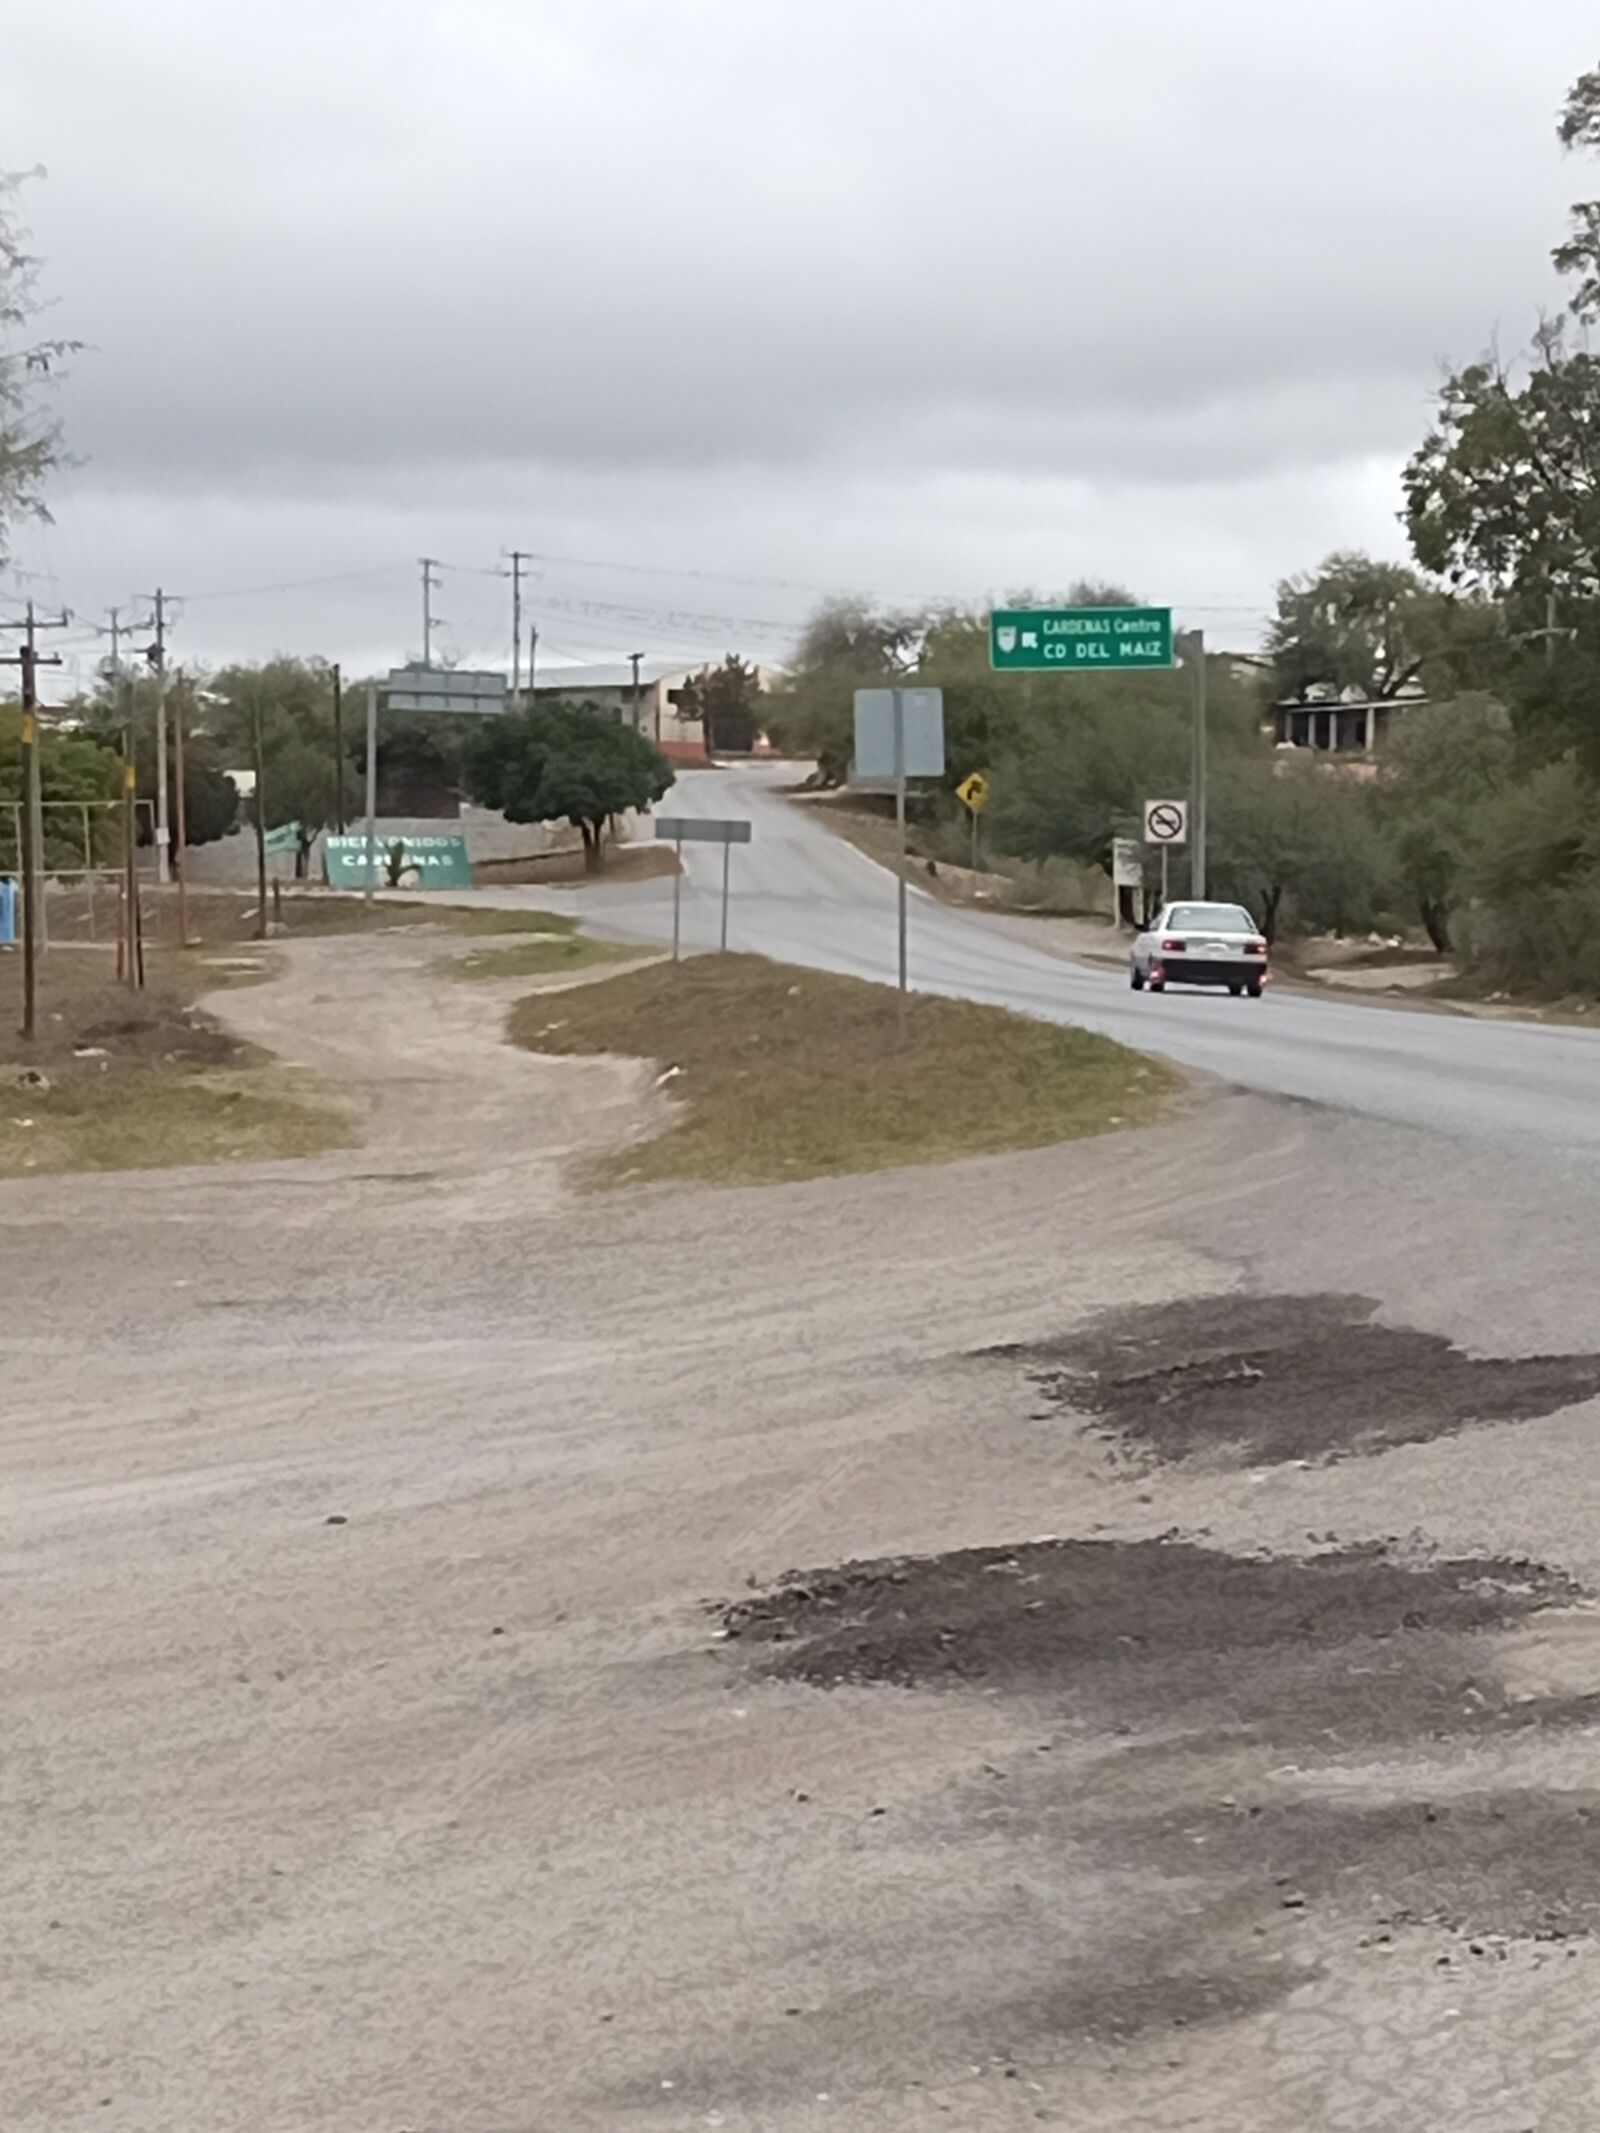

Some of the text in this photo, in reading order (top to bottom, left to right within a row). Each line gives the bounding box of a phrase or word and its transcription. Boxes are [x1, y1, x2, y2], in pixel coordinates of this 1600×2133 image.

[1043, 618, 1161, 635] CARDENAS Centro
[1043, 641, 1162, 659] CD DEL MAIZ
